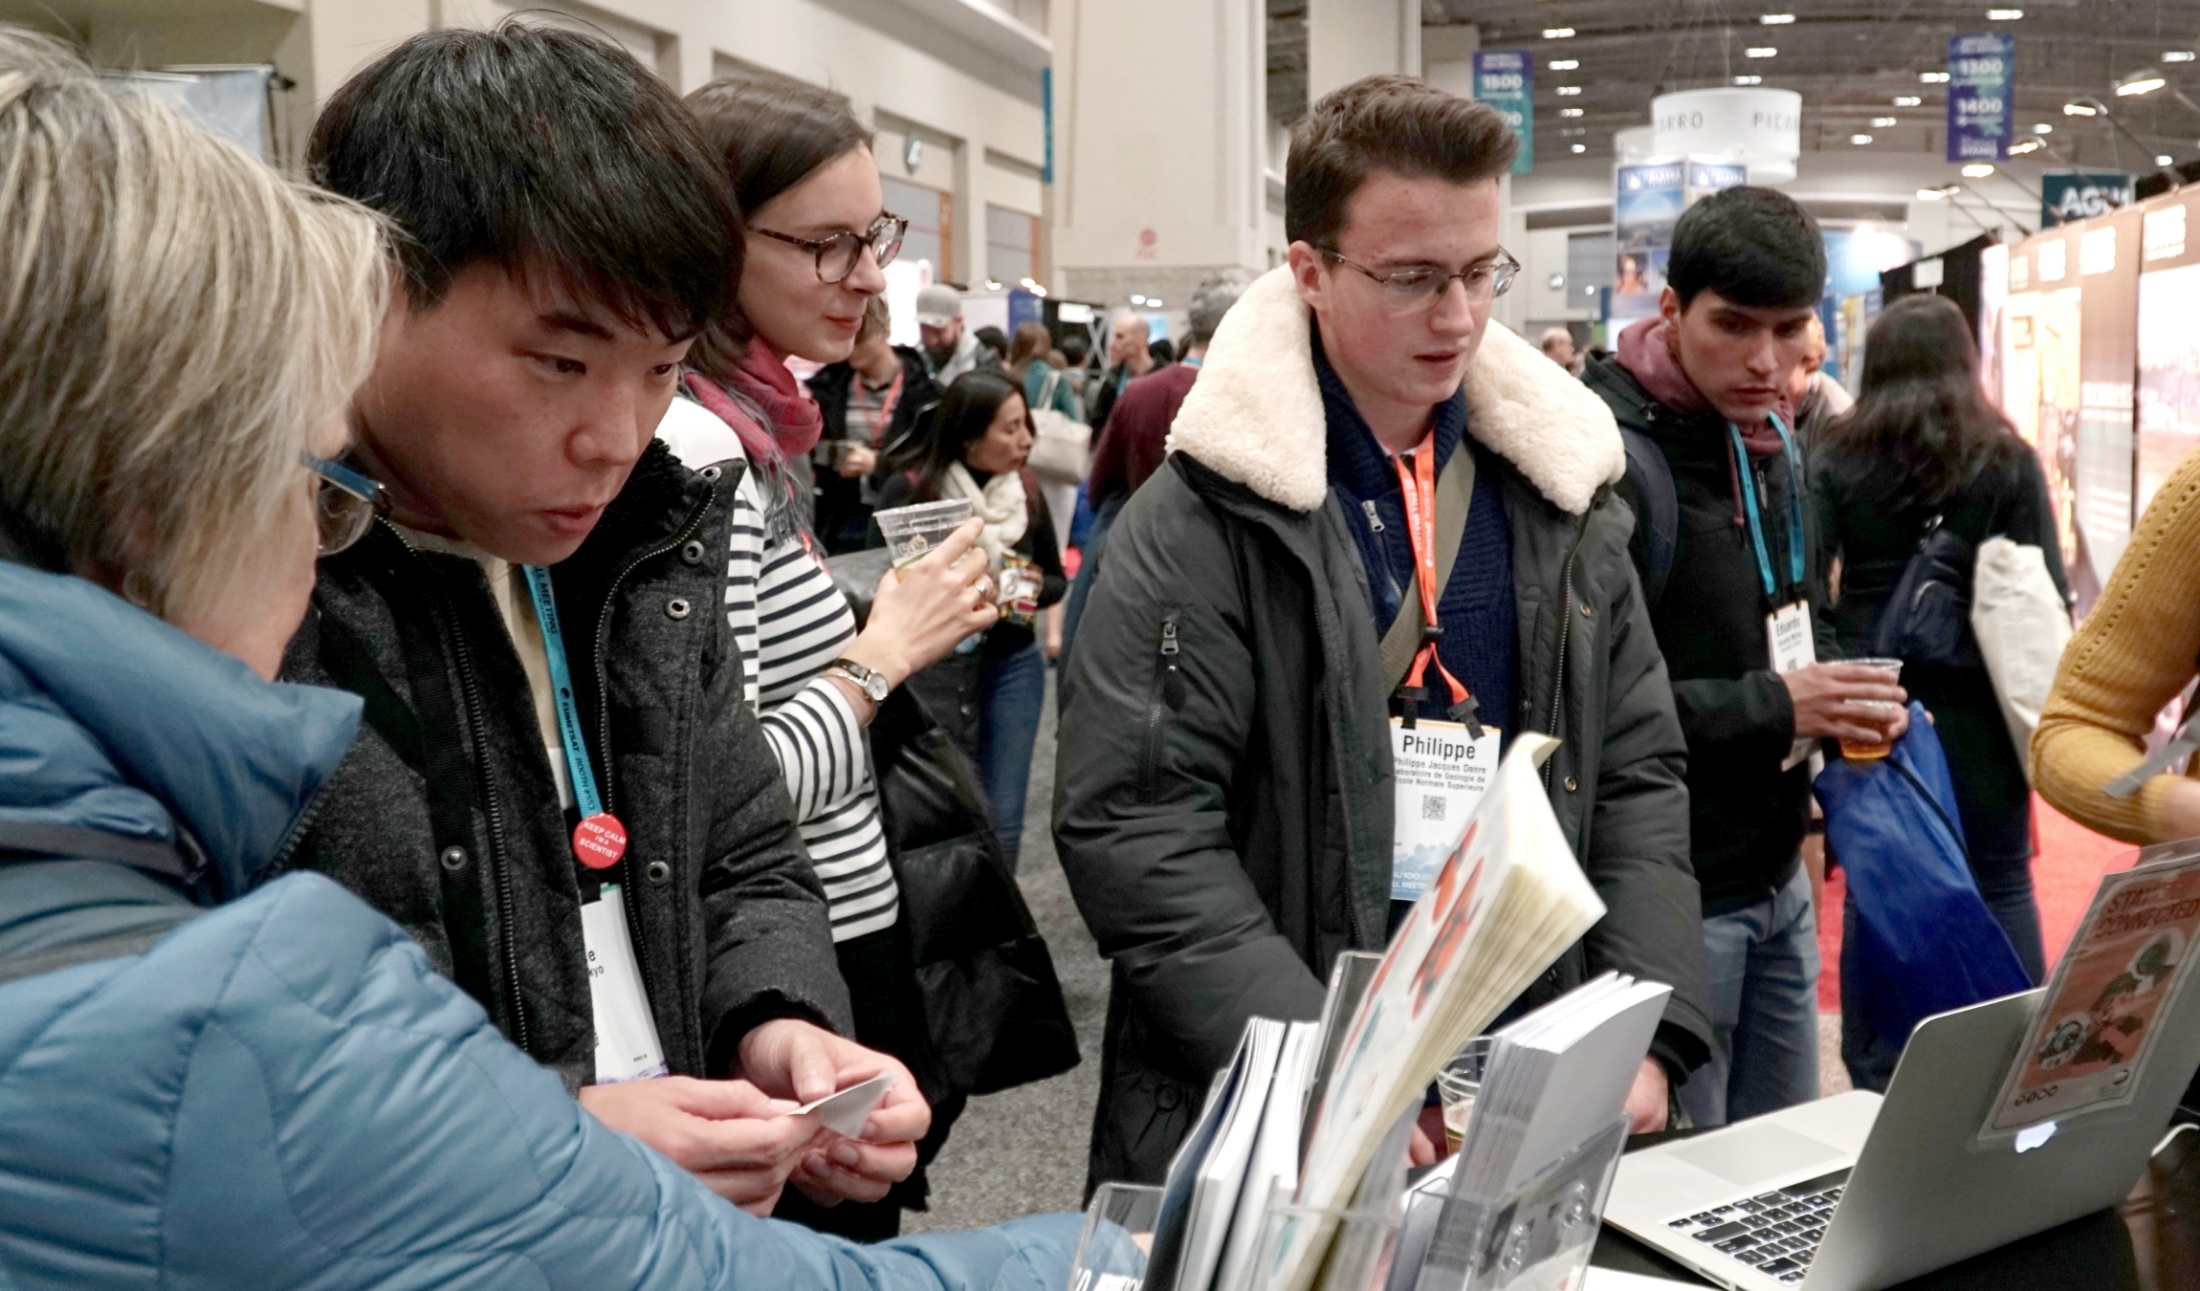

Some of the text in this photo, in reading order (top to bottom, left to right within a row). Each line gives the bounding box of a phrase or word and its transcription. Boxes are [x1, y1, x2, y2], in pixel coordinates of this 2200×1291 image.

[1957, 98, 2003, 115] 1400
[539, 582, 559, 635] MEETING
[563, 702, 596, 811] EUMETSAT BOOTH #553
[1402, 735, 1476, 762] Philippe
[1428, 760, 1460, 773] Jacques
[1416, 778, 1445, 789] Normale
[1447, 781, 1485, 792] Superieure
[1434, 771, 1442, 779] de
[1444, 772, 1475, 783] Geologie
[1477, 776, 1486, 784] de
[583, 821, 627, 845] KEEP CALM
[579, 838, 618, 859] SCIENTIST
